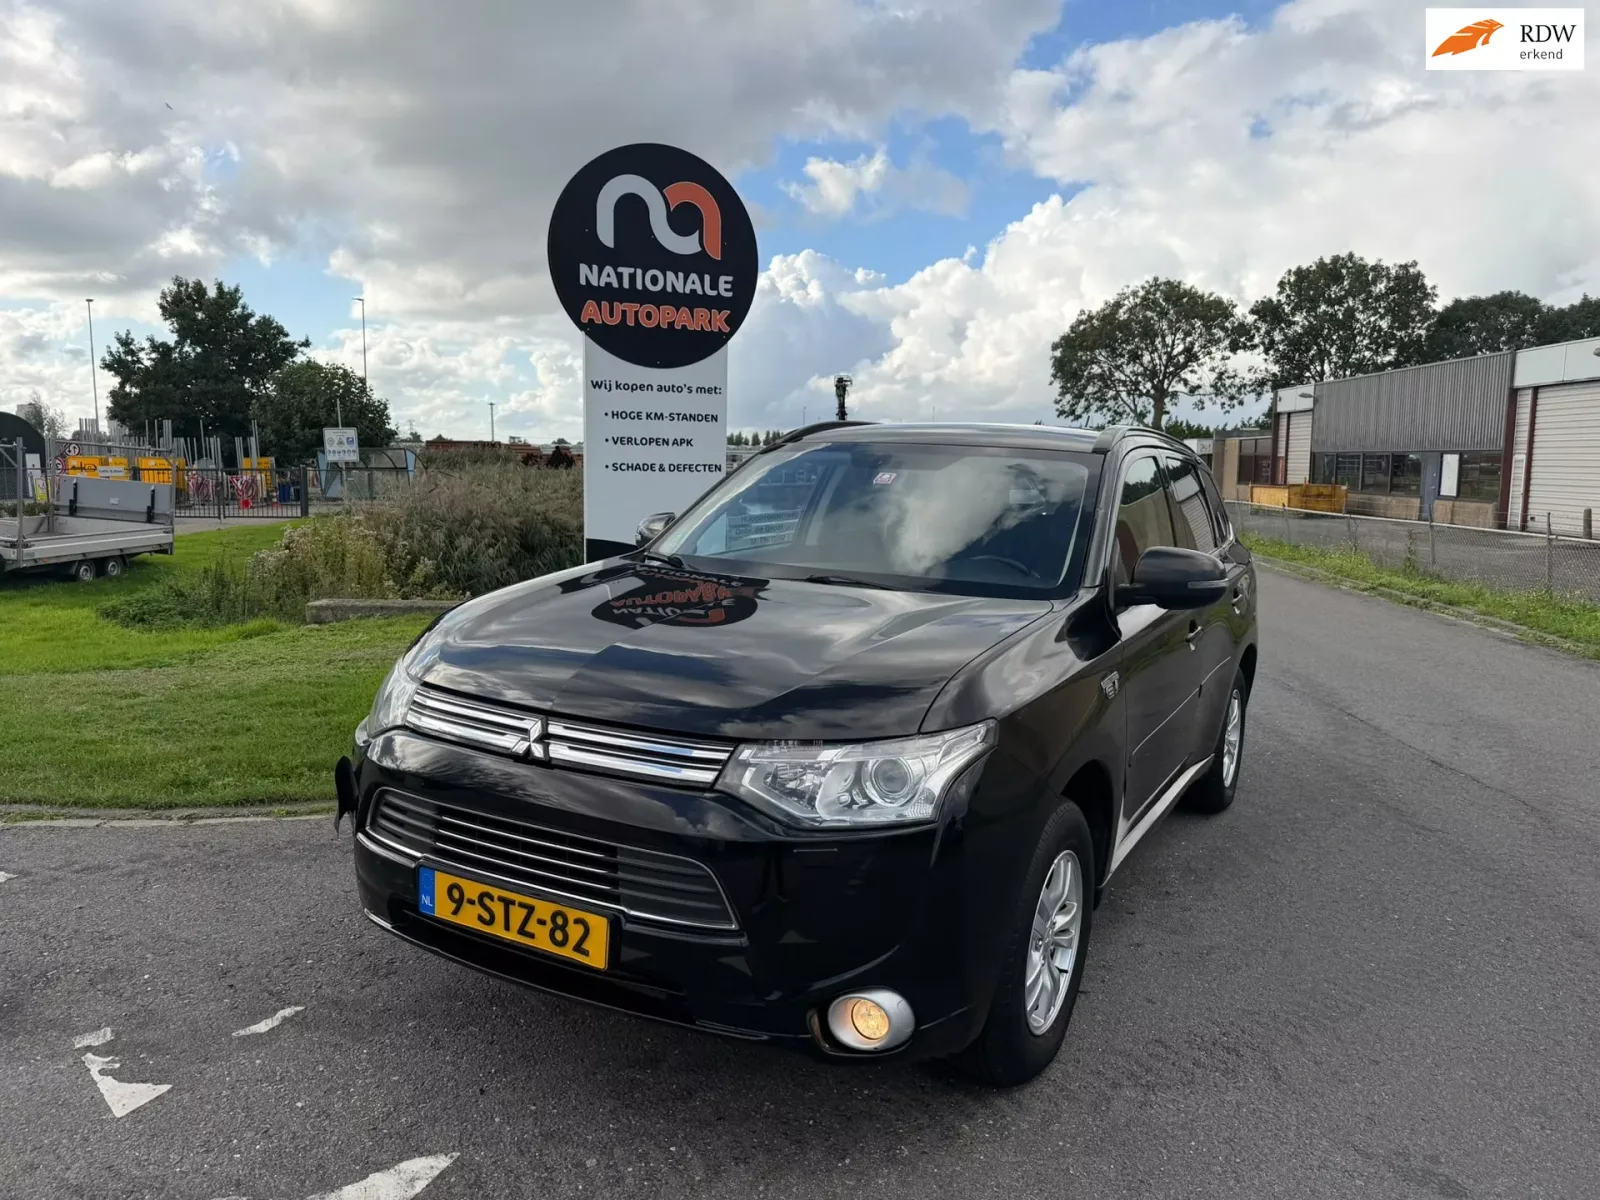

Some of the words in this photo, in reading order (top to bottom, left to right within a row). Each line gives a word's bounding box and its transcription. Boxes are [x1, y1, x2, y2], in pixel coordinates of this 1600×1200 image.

[579, 263, 733, 297] NATIONALE
[580, 300, 731, 332] AUTOPARK
[591, 379, 612, 393] Wij
[615, 380, 653, 393] kopen
[656, 383, 693, 394] auto's
[695, 385, 722, 395] met:
[611, 410, 643, 421] HOGE
[645, 411, 719, 423] KM-STANDEN
[612, 436, 670, 447] VERLOPEN
[671, 438, 694, 447] APK
[612, 462, 657, 472] SCHADE
[658, 463, 666, 472] &
[668, 463, 722, 473] DEFECTEN
[421, 894, 434, 907] NL
[446, 882, 591, 957] 9-STZ-82
